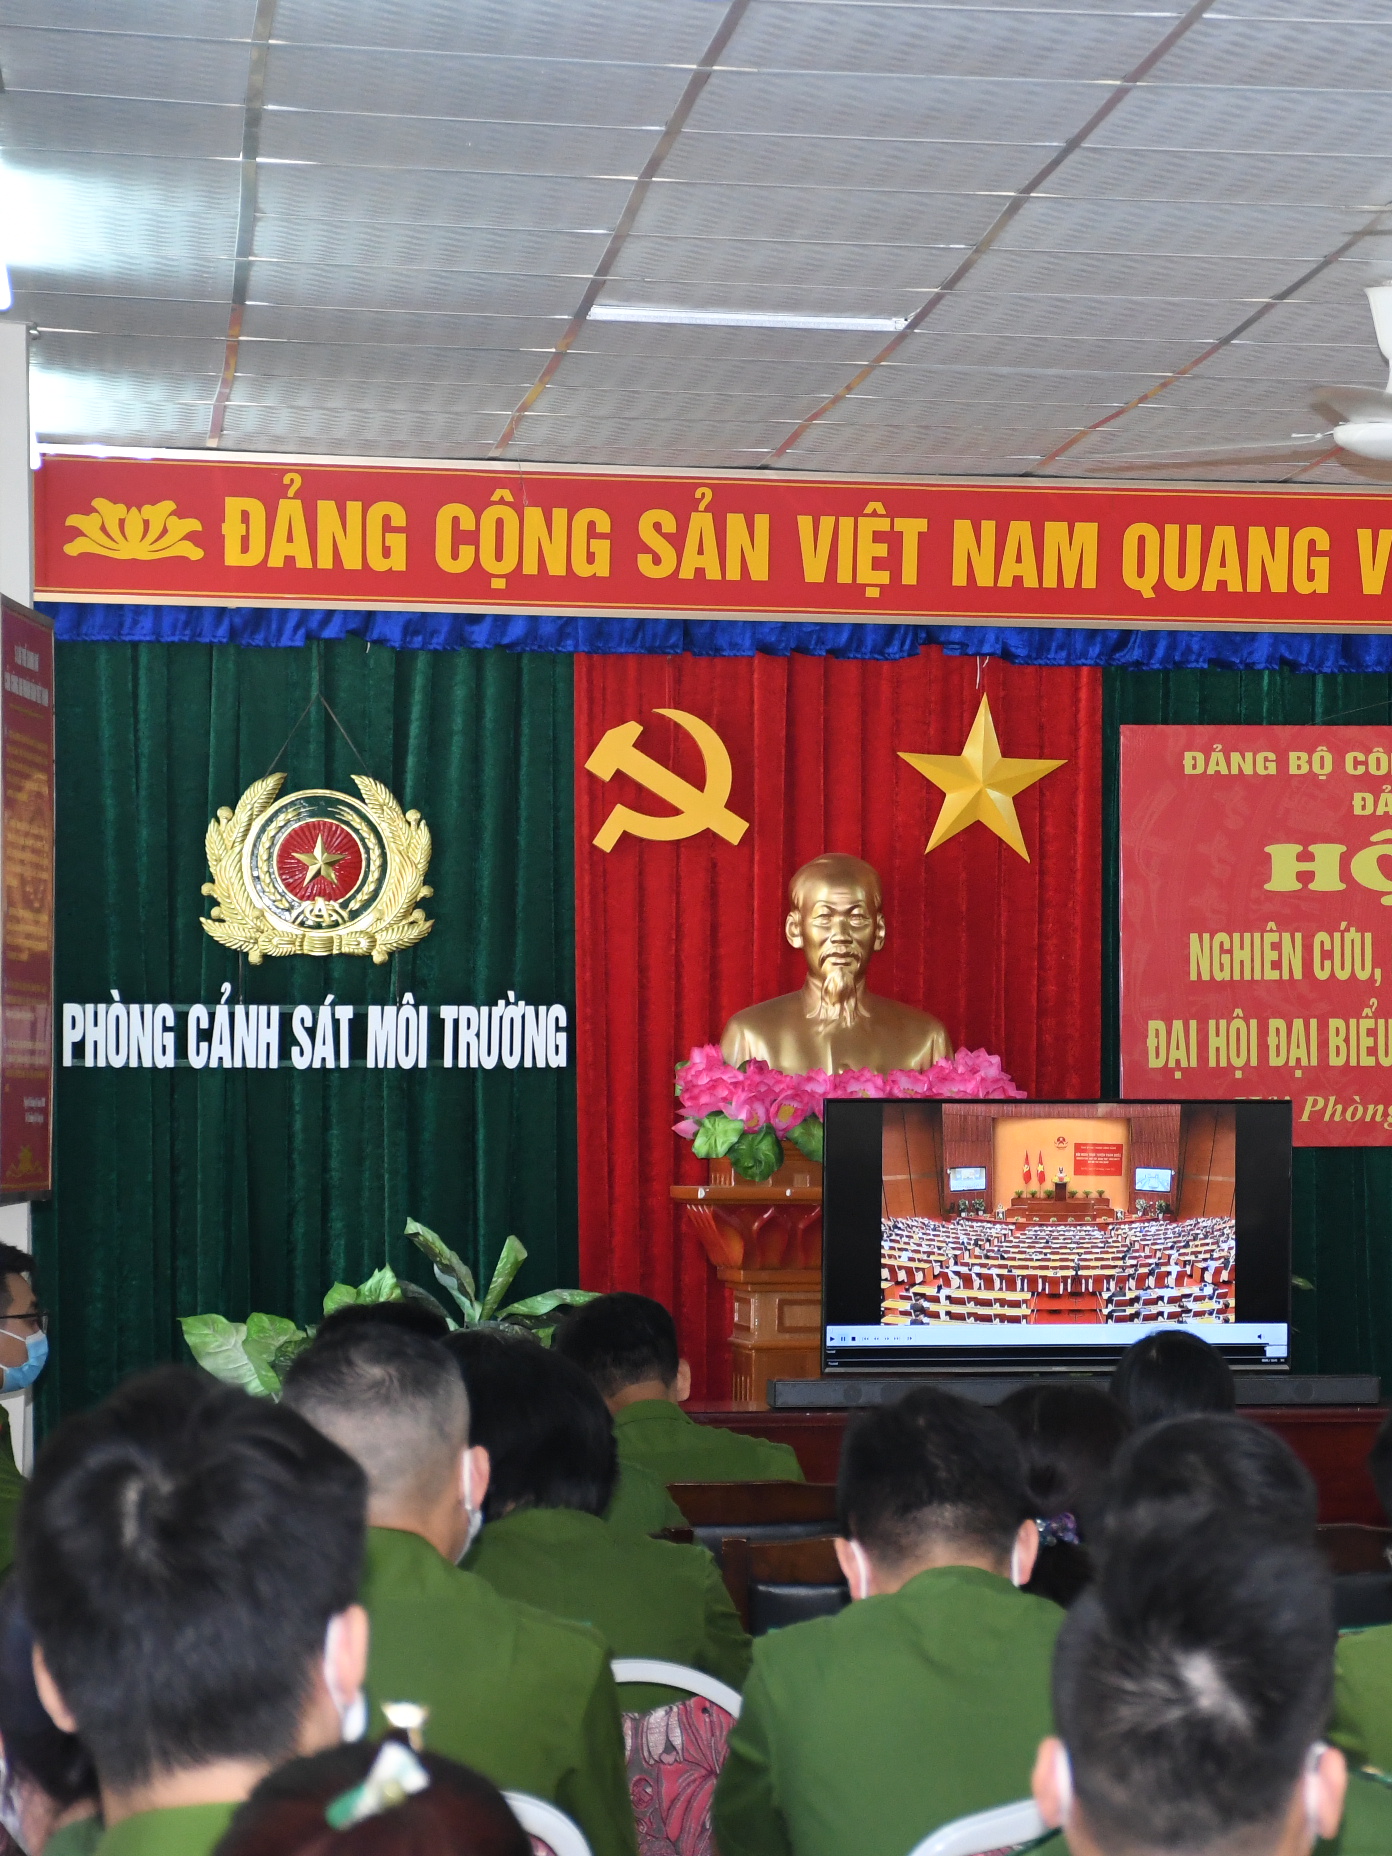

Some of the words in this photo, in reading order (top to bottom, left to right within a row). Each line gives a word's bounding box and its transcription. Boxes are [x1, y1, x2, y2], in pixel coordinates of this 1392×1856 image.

[222, 472, 406, 571] ĐẢNG
[435, 489, 611, 589] CỘNG
[637, 487, 769, 581] SẢN
[797, 502, 928, 597] VIỆT
[950, 519, 1098, 589] NAM
[1122, 521, 1330, 599] QUANG
[1184, 744, 1277, 775] ĐẢNG
[1289, 746, 1333, 780] BỘ
[1190, 922, 1302, 981] NGHIÊN
[1313, 921, 1381, 986] CỨU,
[63, 990, 174, 1068] PHÒNG
[188, 982, 279, 1068] CẢNH
[292, 995, 353, 1069] SÁT
[367, 993, 427, 1069] MÔI
[441, 991, 566, 1069] TRƯỜNG
[1147, 1020, 1197, 1079] ĐẠI
[1209, 1008, 1257, 1078] HỘI
[1268, 1018, 1317, 1077] ĐẠI
